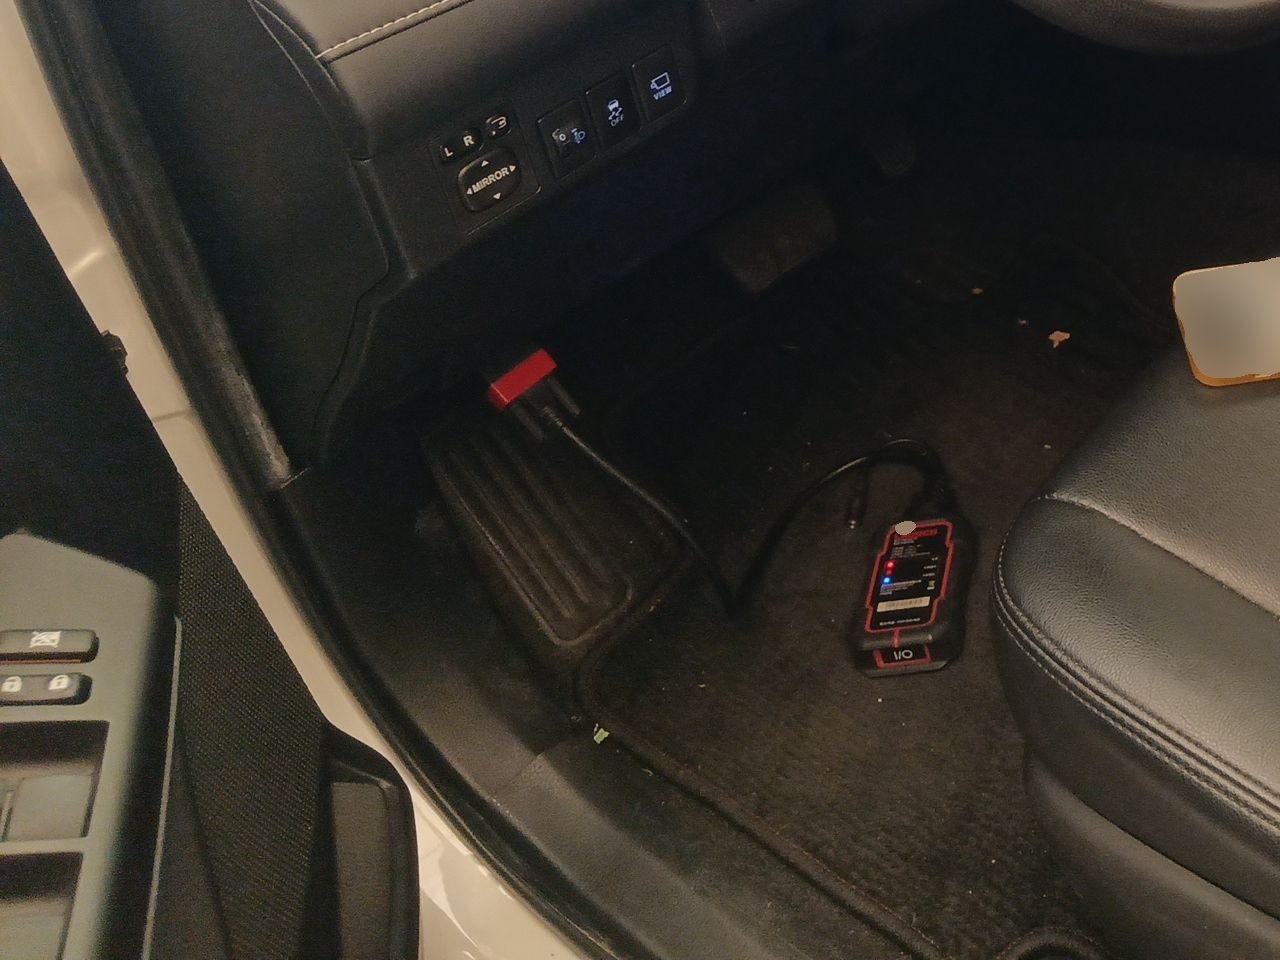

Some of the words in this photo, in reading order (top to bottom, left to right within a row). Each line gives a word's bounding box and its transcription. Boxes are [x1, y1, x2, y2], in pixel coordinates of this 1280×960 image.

[653, 85, 672, 100] VIEW
[610, 114, 624, 127] OFF
[463, 135, 474, 147] R
[444, 147, 453, 157] L
[472, 167, 510, 193] MIRROR
